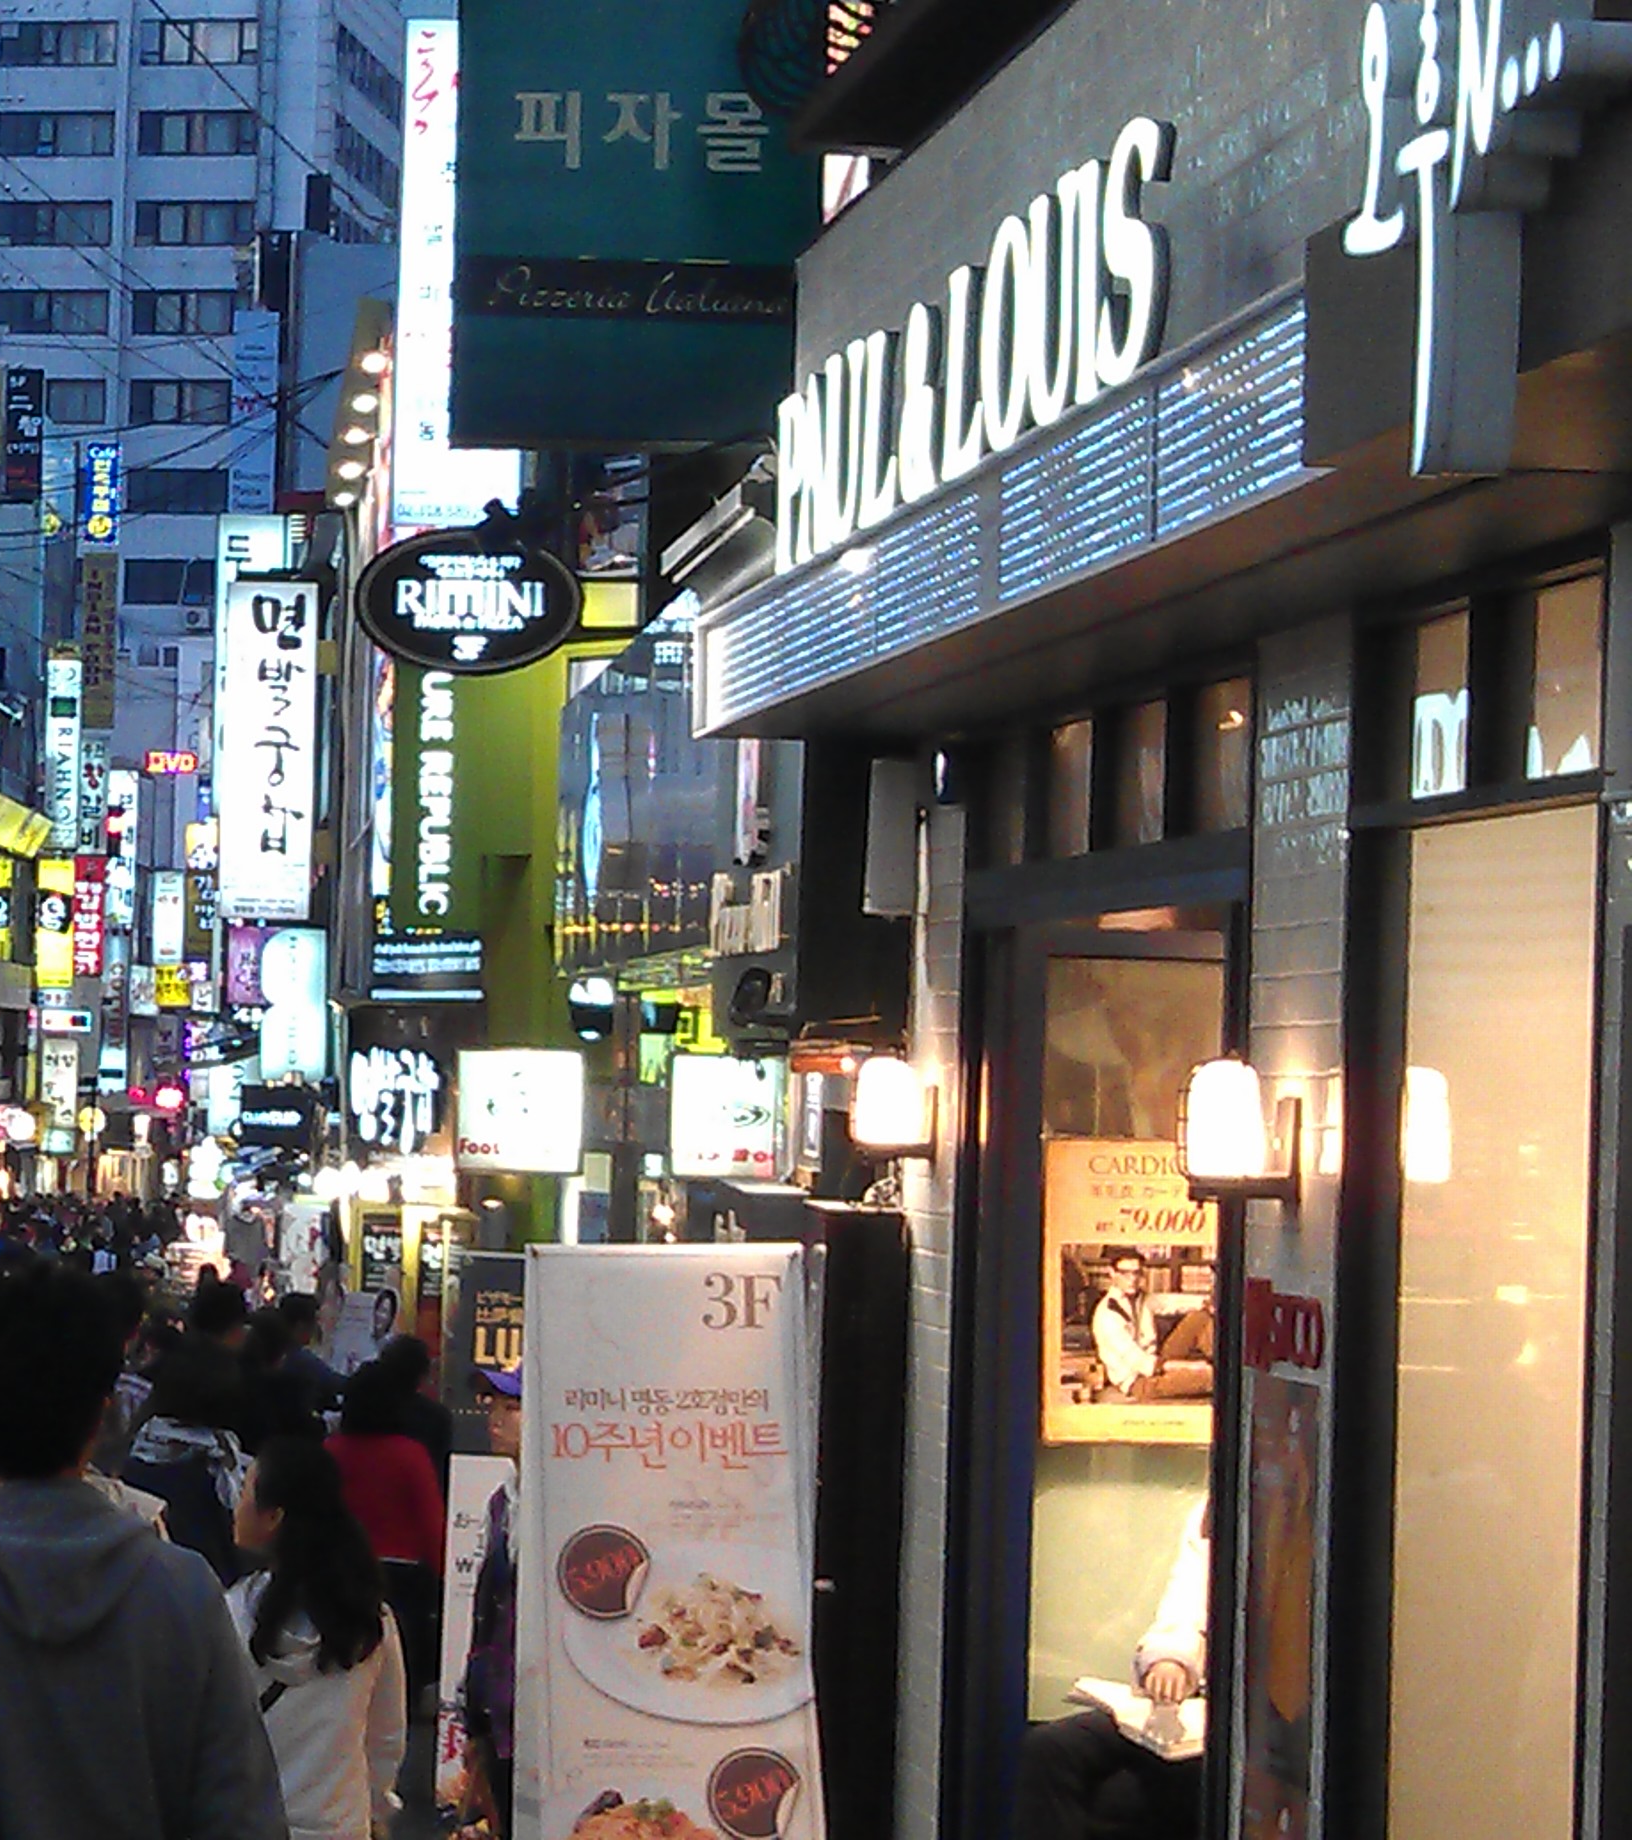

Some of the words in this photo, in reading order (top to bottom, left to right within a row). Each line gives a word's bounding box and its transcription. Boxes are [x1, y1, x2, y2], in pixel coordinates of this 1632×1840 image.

[514, 90, 770, 174] 피자몰
[147, 751, 197, 772] DVD
[418, 750, 454, 916] REPUBLIC
[702, 1271, 782, 1331] 3F
[563, 1387, 628, 1412] 리미니
